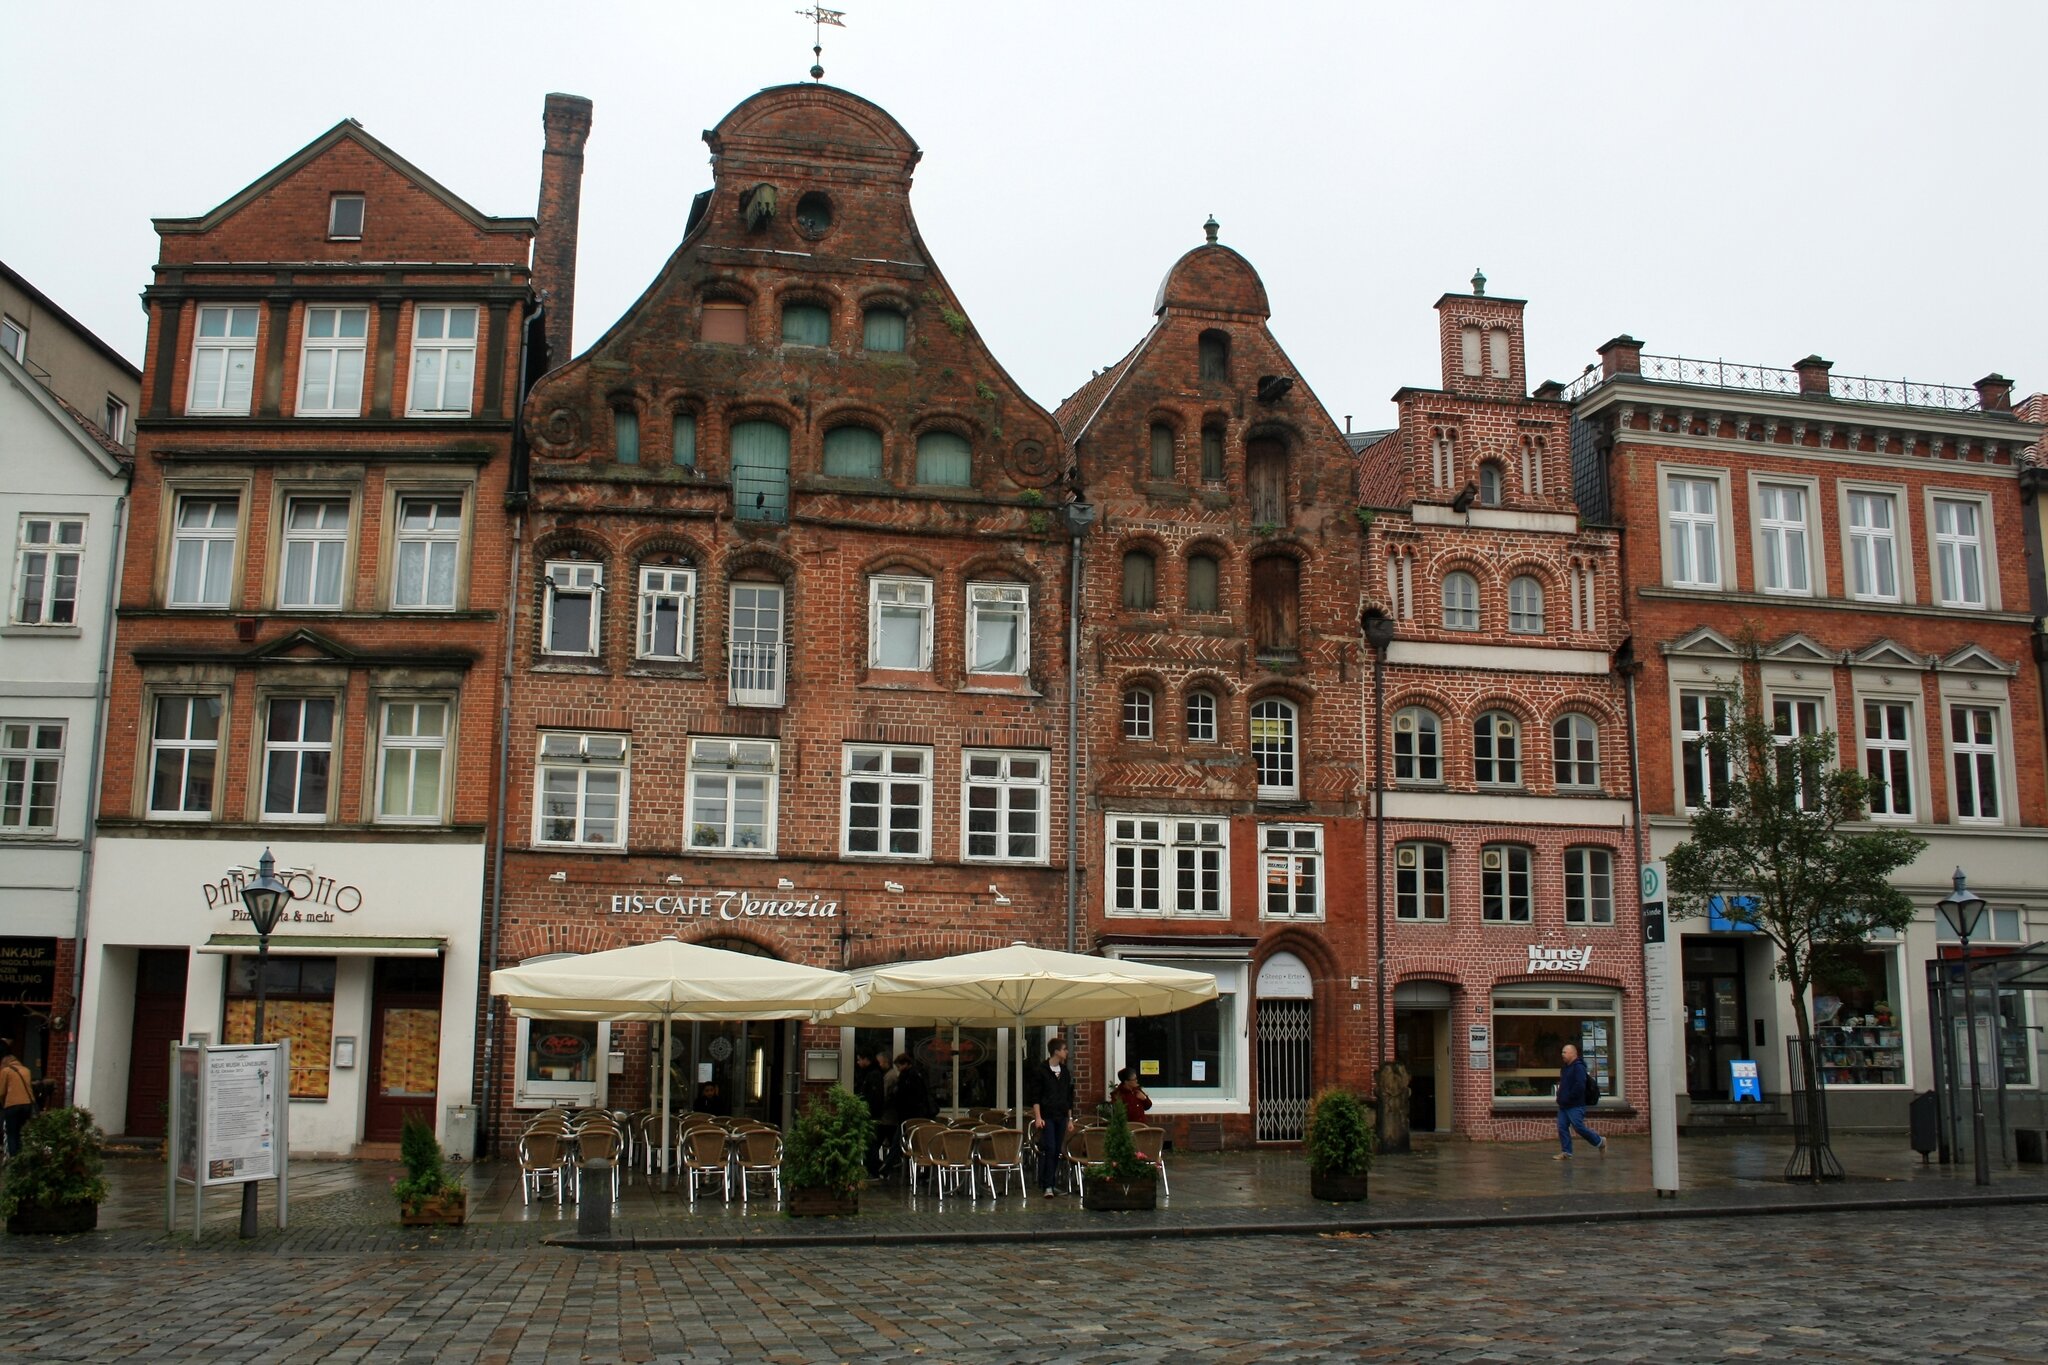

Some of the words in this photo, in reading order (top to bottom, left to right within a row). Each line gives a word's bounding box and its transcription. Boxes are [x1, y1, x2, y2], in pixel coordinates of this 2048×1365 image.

[203, 872, 362, 913] PANOTTO
[306, 911, 335, 923] mehr
[611, 895, 712, 916] EIS-CAFE
[716, 891, 838, 921] Venezia
[1646, 925, 1653, 940] C
[0, 947, 45, 958] NKAUF
[1527, 945, 1592, 974] post
